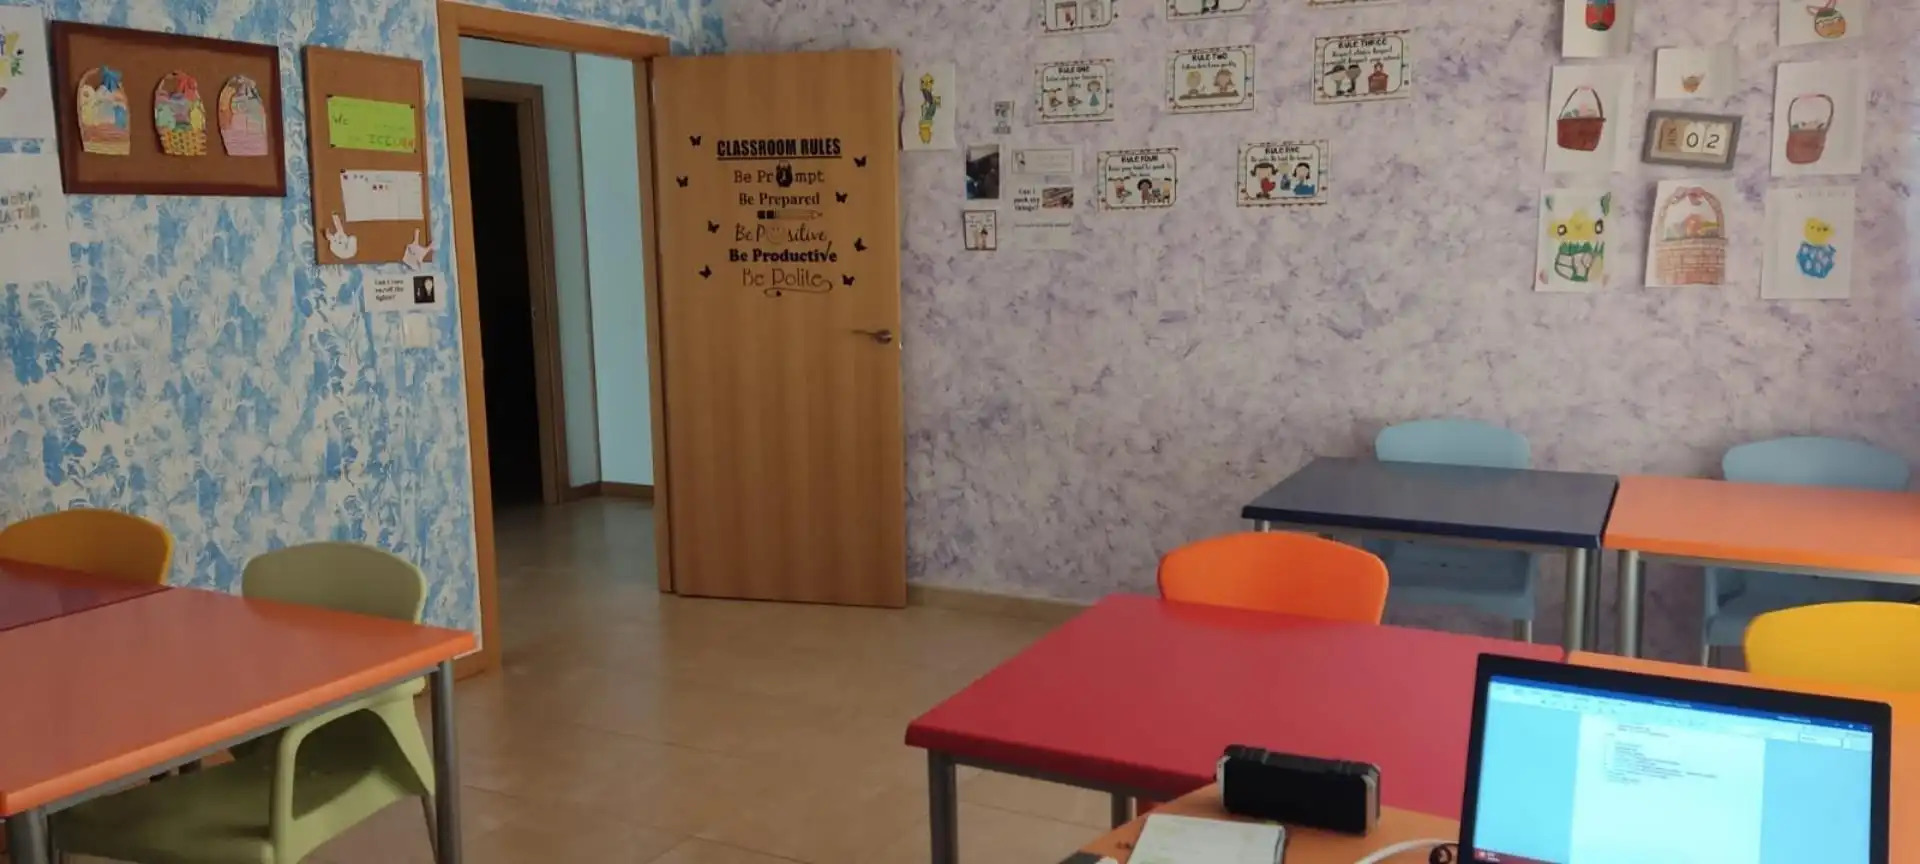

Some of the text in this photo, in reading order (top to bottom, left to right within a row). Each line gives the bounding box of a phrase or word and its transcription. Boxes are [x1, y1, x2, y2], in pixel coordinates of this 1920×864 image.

[1360, 38, 1387, 47] THREE
[1192, 52, 1228, 61] RULE TWO
[1059, 65, 1090, 74] RULE ONE
[717, 138, 841, 157] CLASSROOM RULES
[1121, 154, 1158, 163] RULE FOUR
[734, 170, 752, 184] Be
[739, 192, 820, 208] Be Prepared
[735, 222, 752, 242] Be
[729, 243, 837, 262] Be Productive
[742, 268, 829, 289] Be Polite
